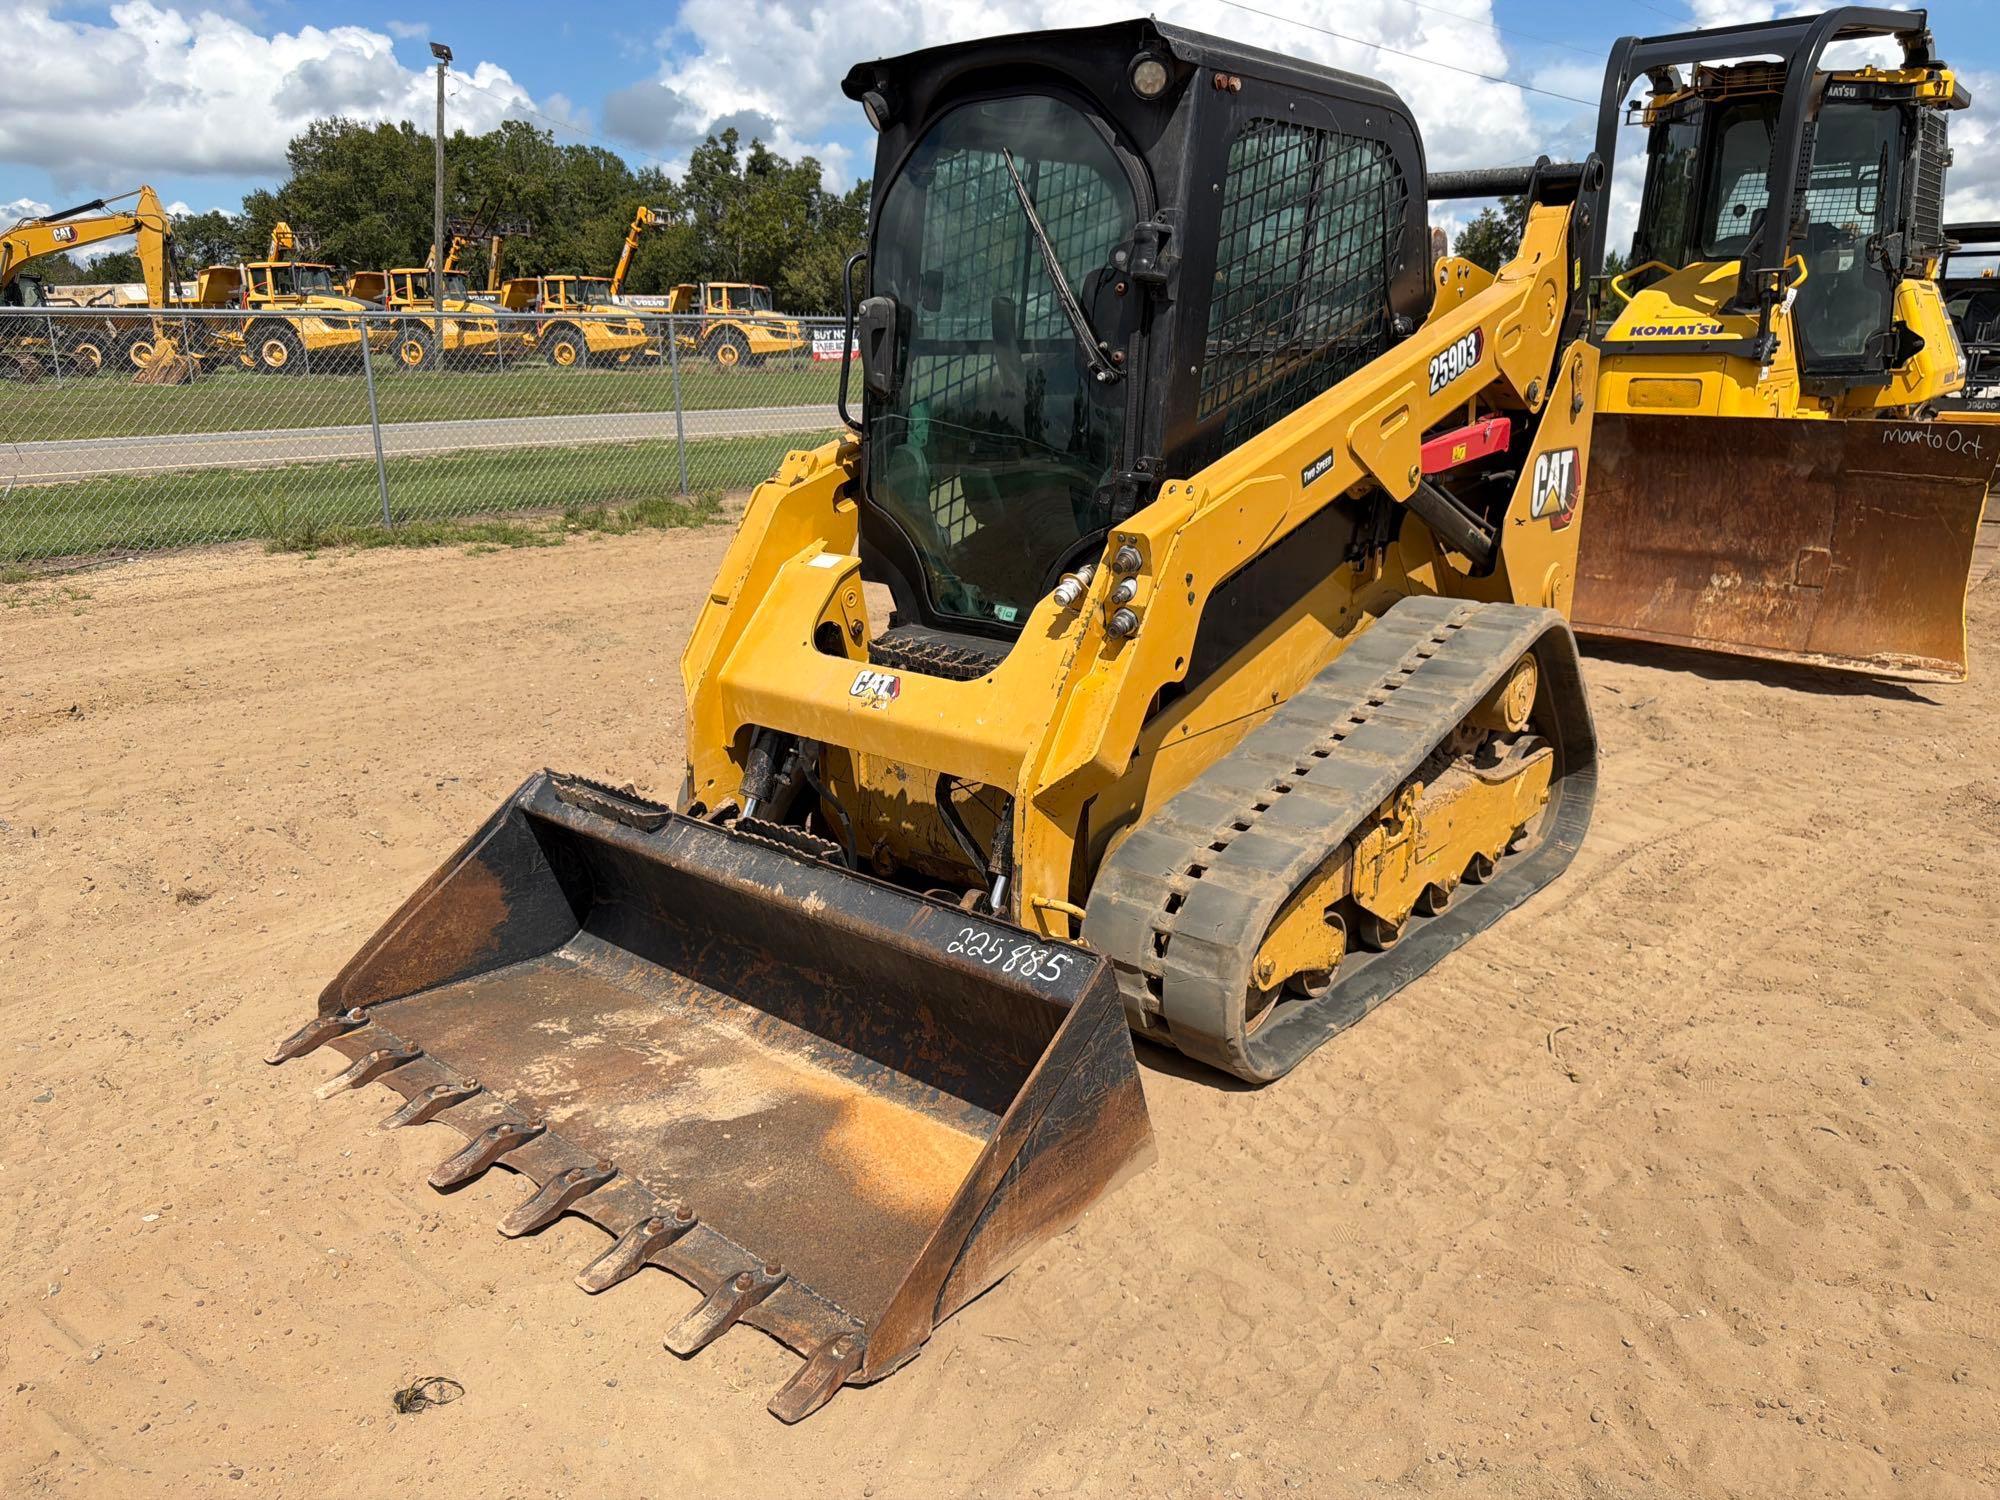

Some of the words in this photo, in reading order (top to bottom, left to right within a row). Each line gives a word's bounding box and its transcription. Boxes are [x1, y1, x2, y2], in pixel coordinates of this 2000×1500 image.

[53, 226, 72, 242] CAT
[813, 329, 831, 340] BUY
[1629, 323, 1725, 336] KOMATSU
[1429, 332, 1477, 395] 259D3
[1922, 424, 1943, 449] to
[1531, 449, 1574, 518] CAT
[850, 669, 896, 697] CAT
[946, 927, 1074, 981] 225885
